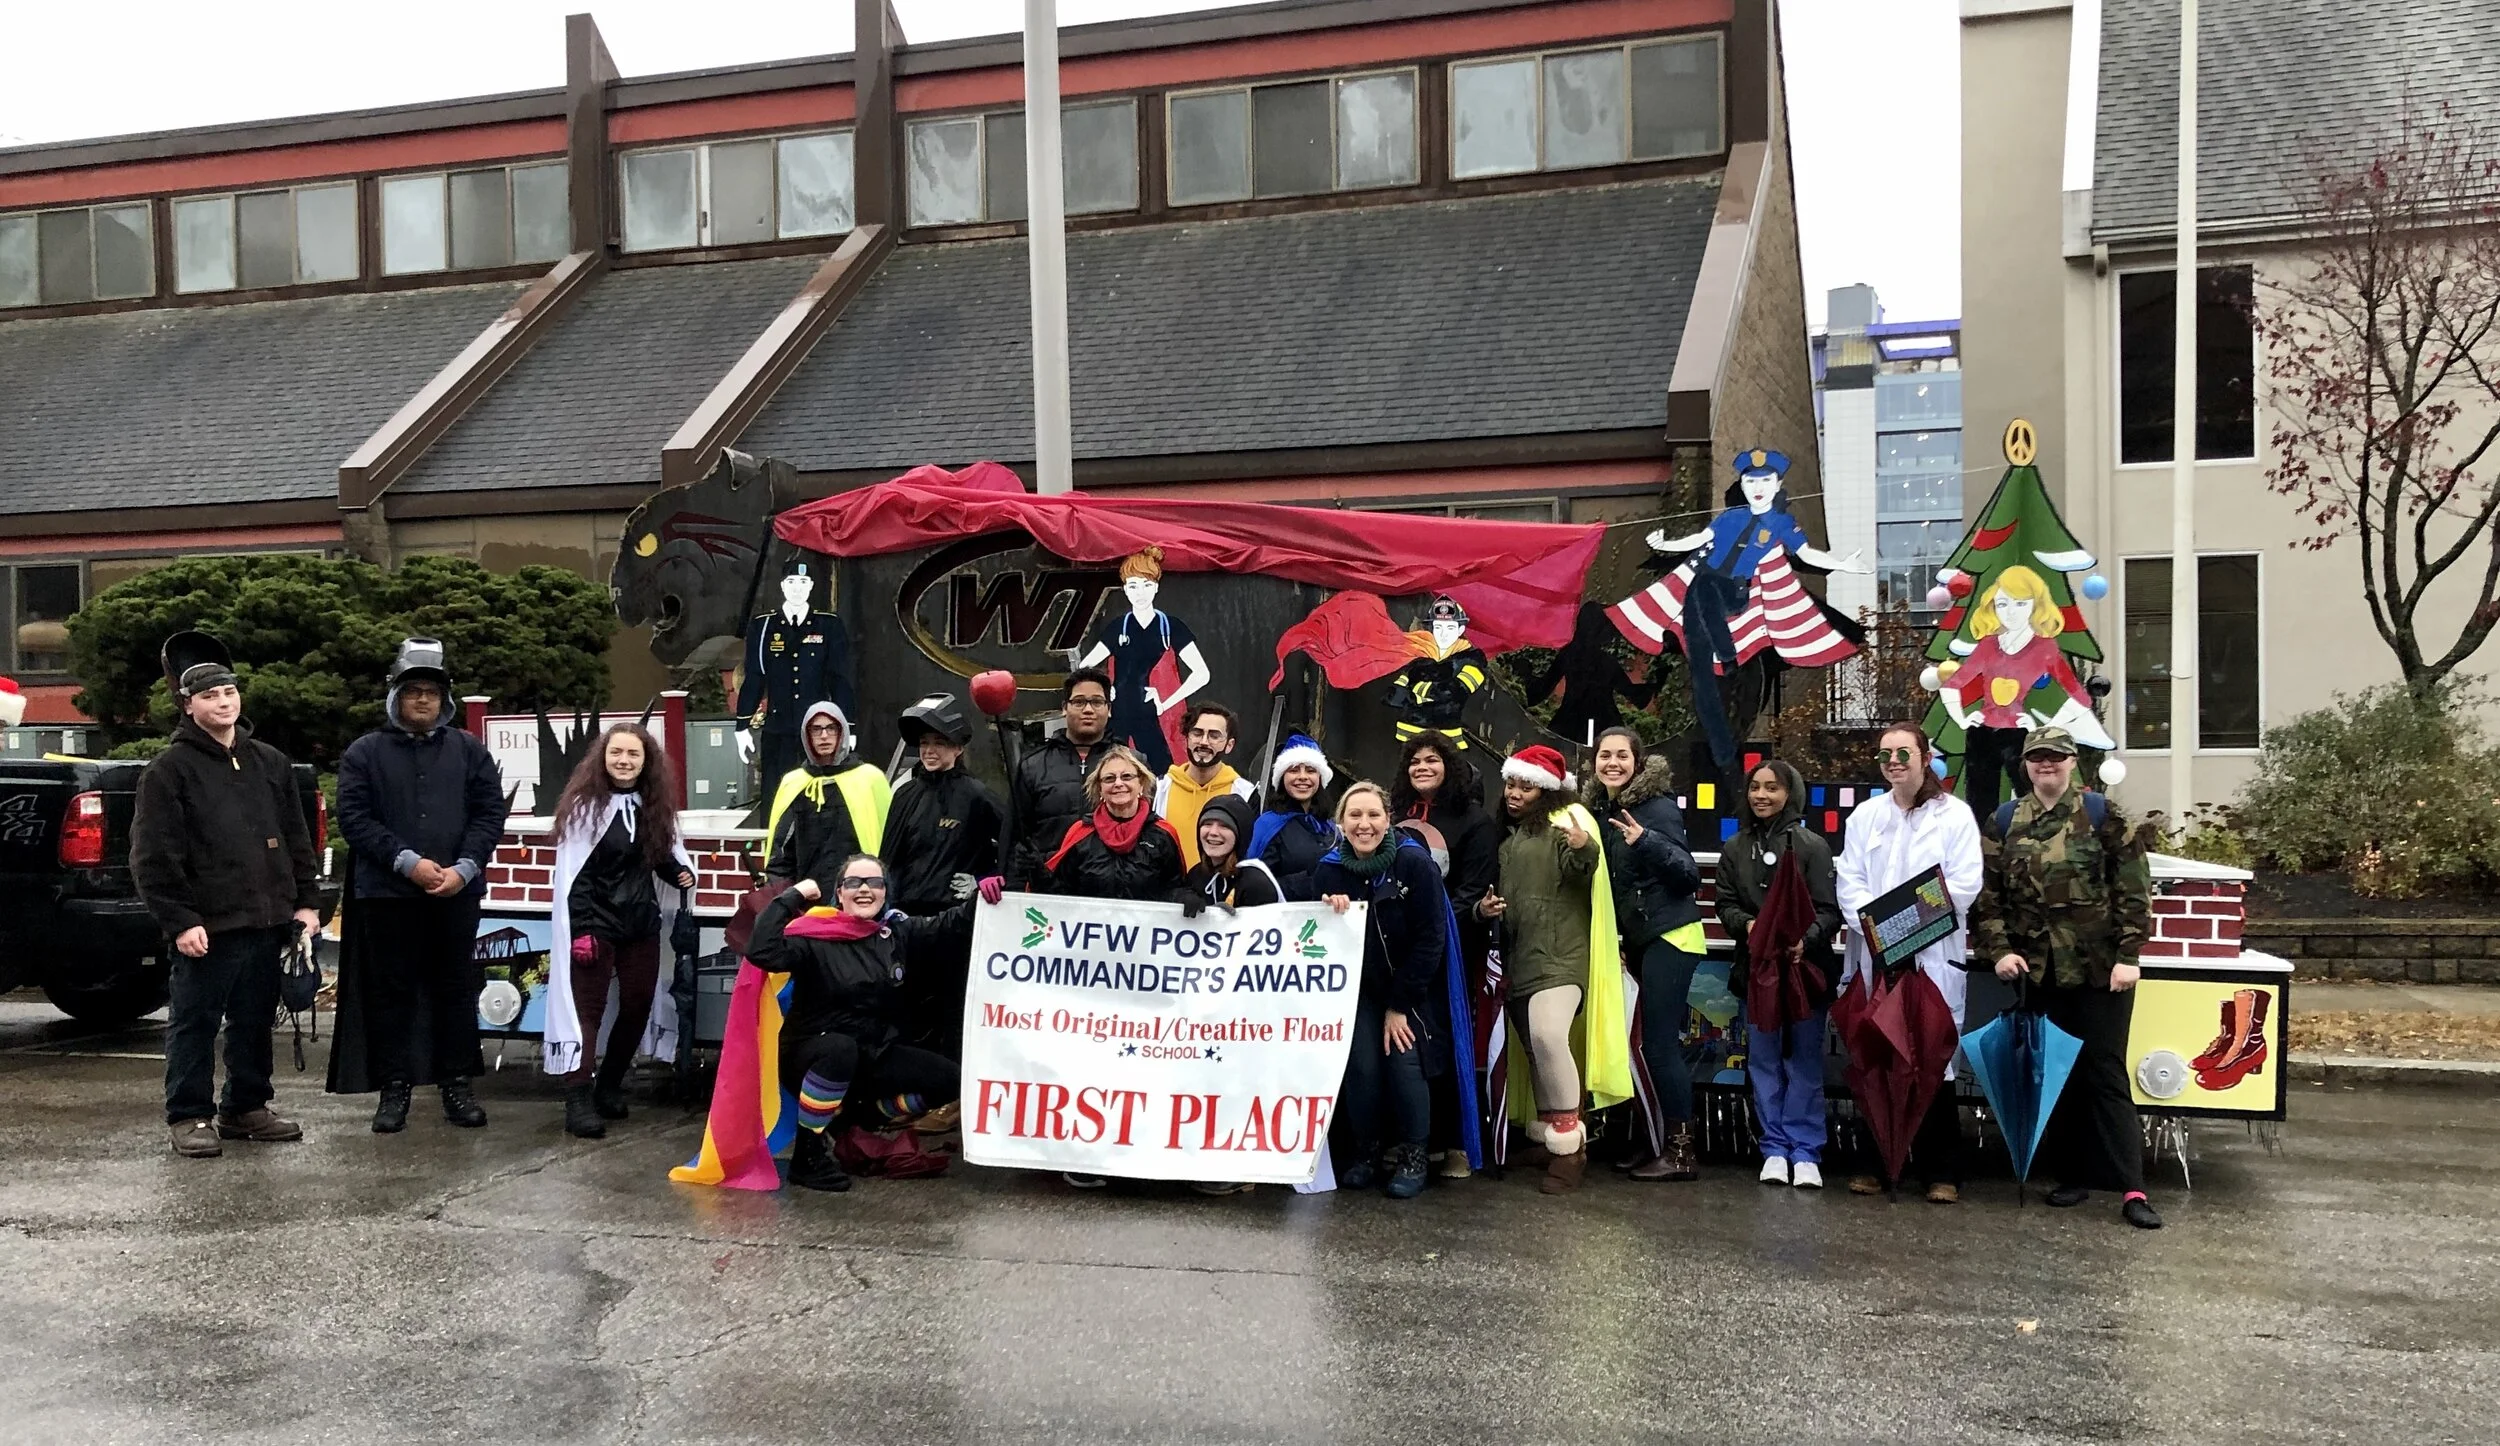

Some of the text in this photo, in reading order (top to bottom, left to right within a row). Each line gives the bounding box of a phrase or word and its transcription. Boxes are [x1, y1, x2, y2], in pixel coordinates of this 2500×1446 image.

[946, 570, 1123, 652] WT
[939, 818, 961, 829] WT
[1060, 921, 1283, 959] VFW POST 29
[987, 952, 1347, 994] COMMANDER'S AWARD
[980, 1003, 1344, 1044] Most Original/Creative Float
[1141, 1045, 1201, 1060] SCHOOL
[972, 1078, 1147, 1147] FIRST
